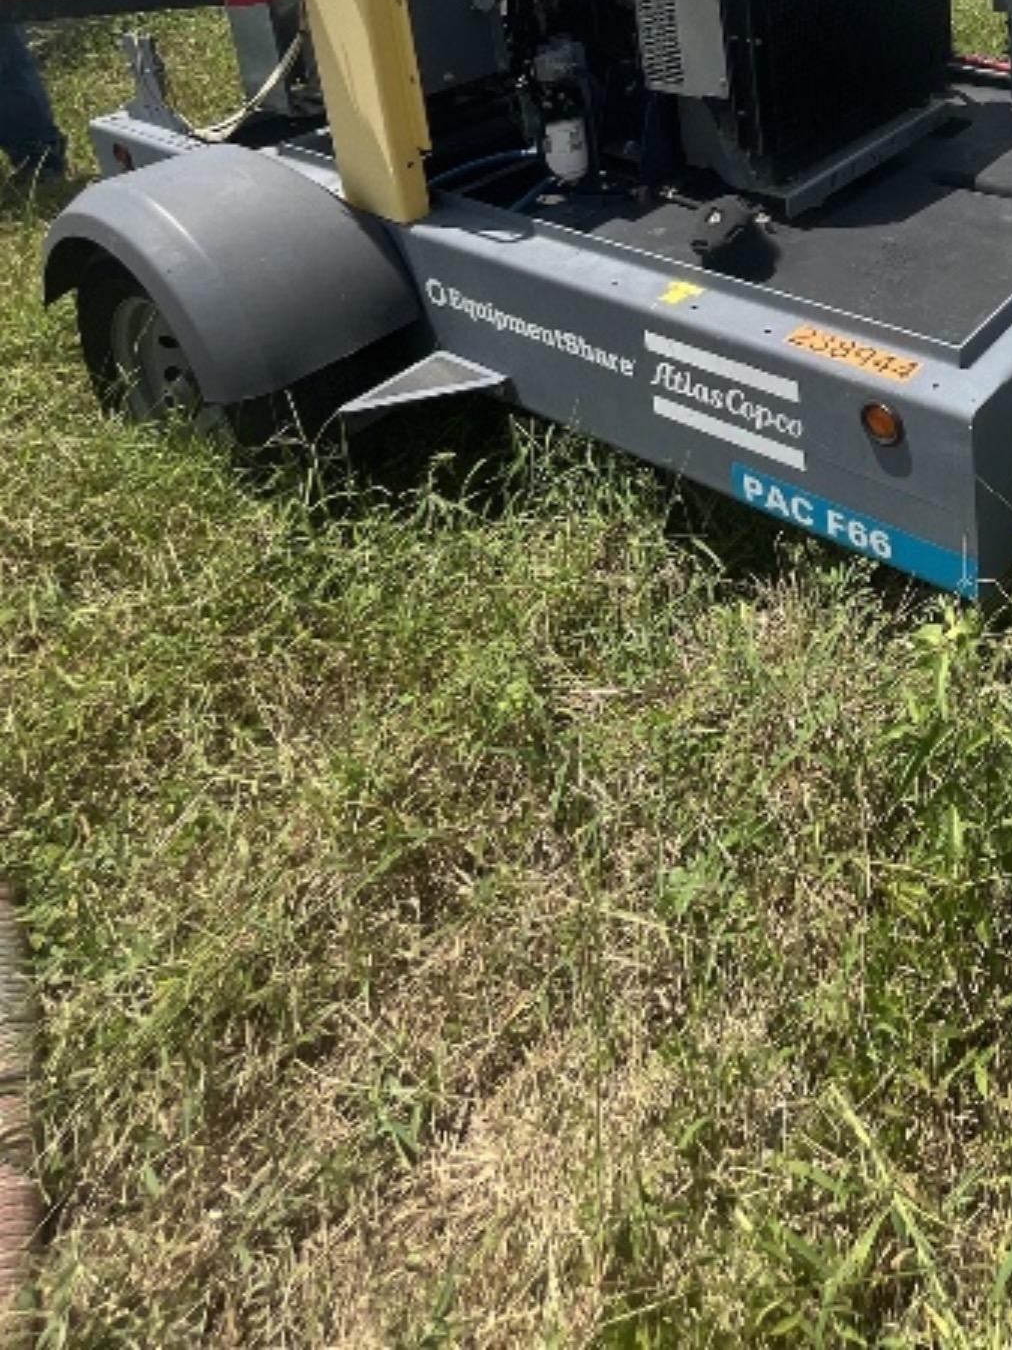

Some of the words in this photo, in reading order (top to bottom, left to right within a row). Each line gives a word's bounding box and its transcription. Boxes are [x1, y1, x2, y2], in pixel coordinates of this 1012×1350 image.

[447, 287, 636, 378] EquipmentShare
[742, 473, 814, 527] PAC
[826, 508, 893, 559] F66
